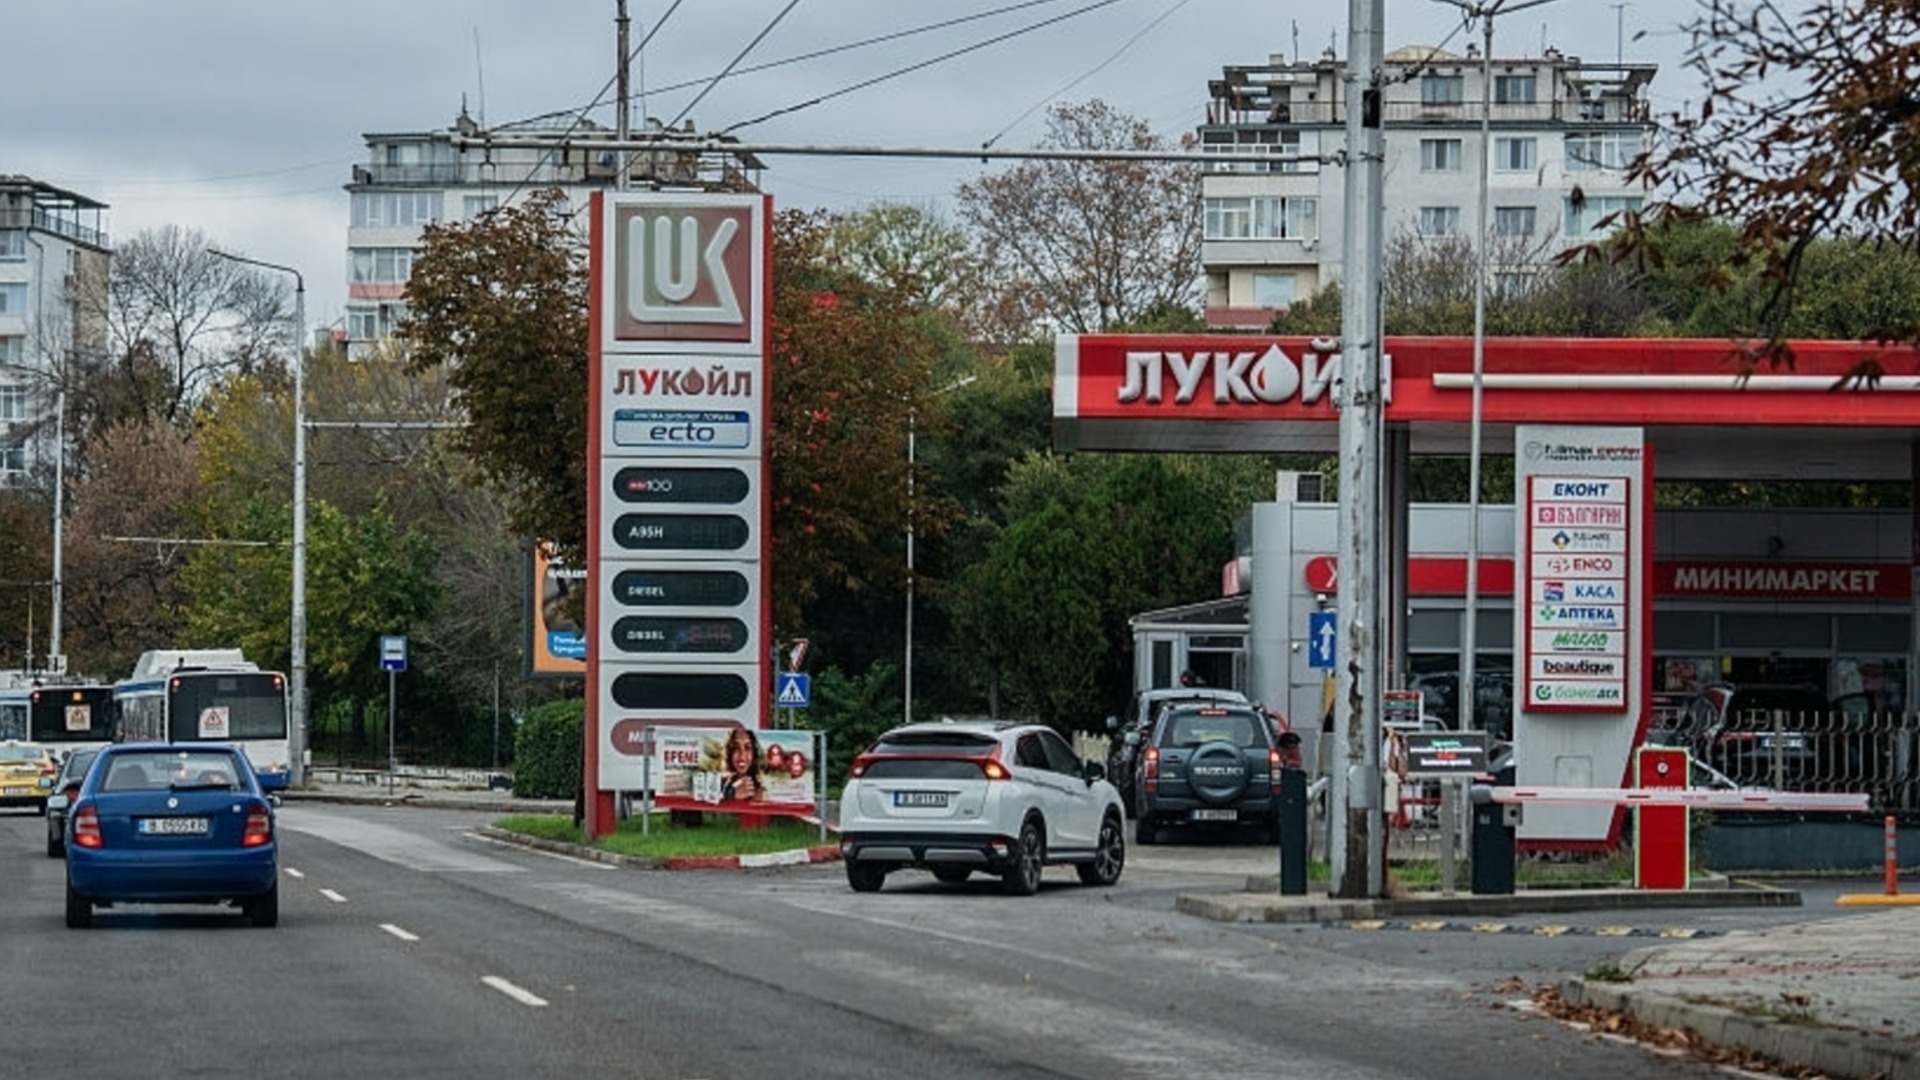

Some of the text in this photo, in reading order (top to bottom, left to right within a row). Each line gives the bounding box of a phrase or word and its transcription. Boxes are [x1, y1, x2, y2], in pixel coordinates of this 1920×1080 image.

[613, 365, 752, 398] ЛУКОЙЛ
[649, 422, 715, 442] ecto
[1553, 483, 1609, 497] ЕКОНТ
[1572, 558, 1613, 571] ENCO
[1674, 567, 1880, 593] МИНИМАРКЕТ
[1575, 585, 1615, 598] КАСА
[1557, 607, 1615, 620] АПТЕКА
[1543, 659, 1614, 675] beautique
